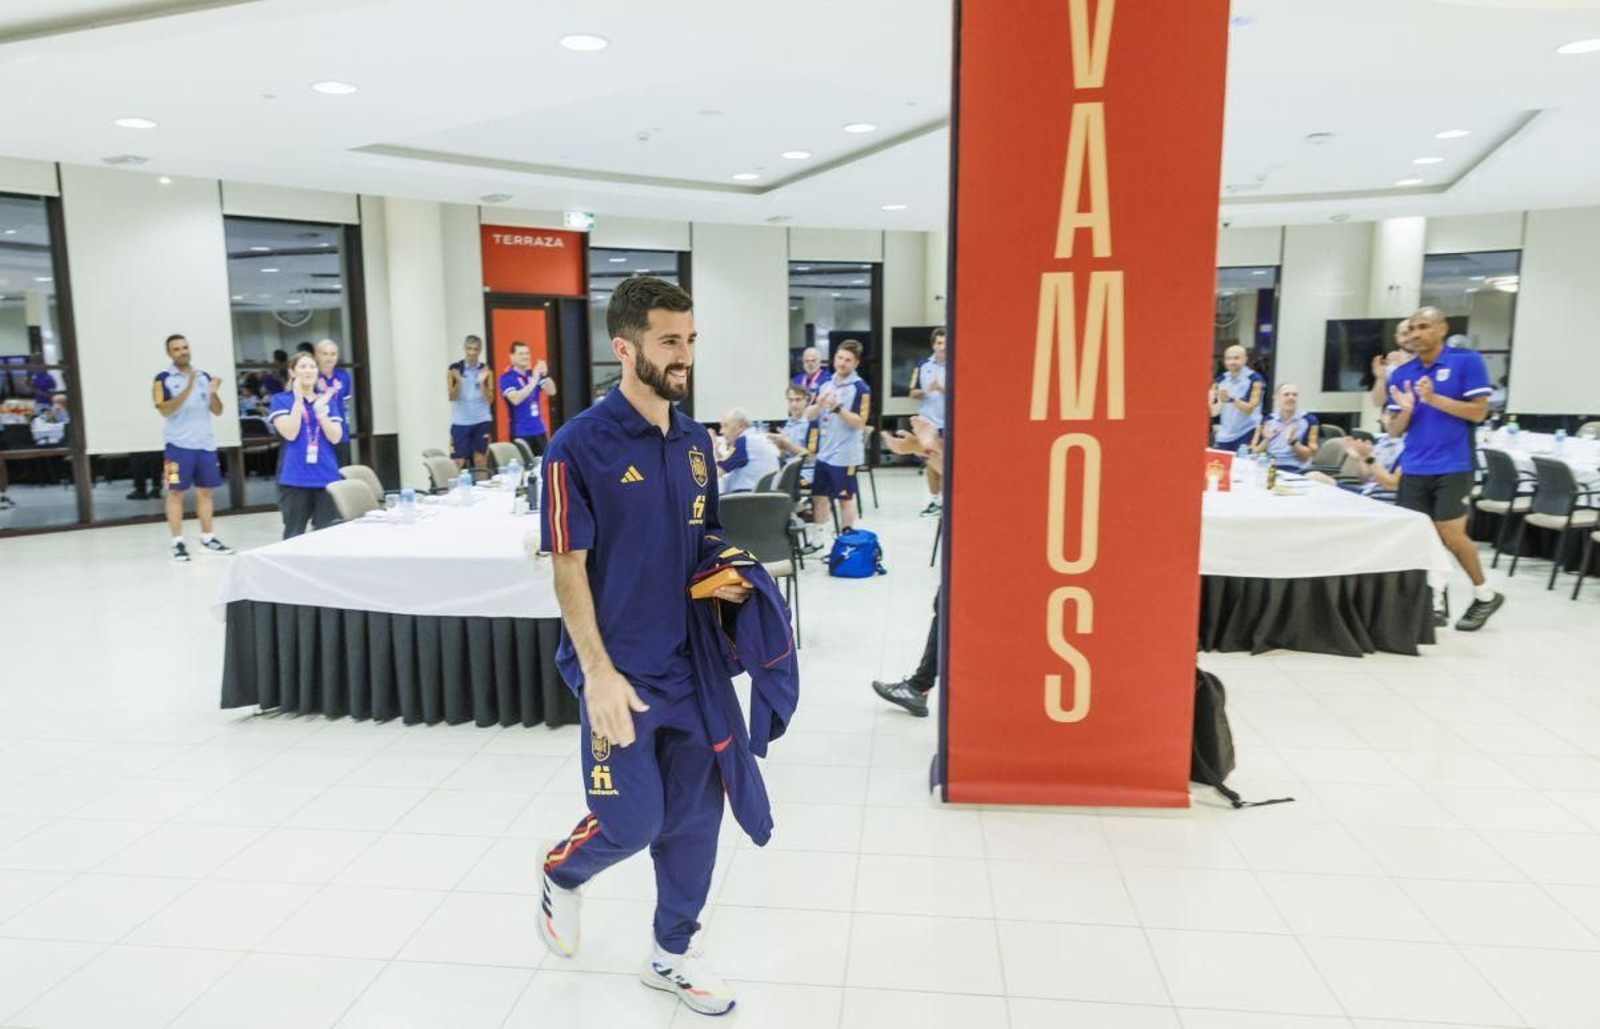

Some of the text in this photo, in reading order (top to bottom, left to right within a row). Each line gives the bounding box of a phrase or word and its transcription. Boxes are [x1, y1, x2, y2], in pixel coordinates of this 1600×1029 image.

[492, 234, 565, 248] TERRAZA
[1030, 0, 1125, 722] VAMOS
[591, 765, 612, 789] fi
